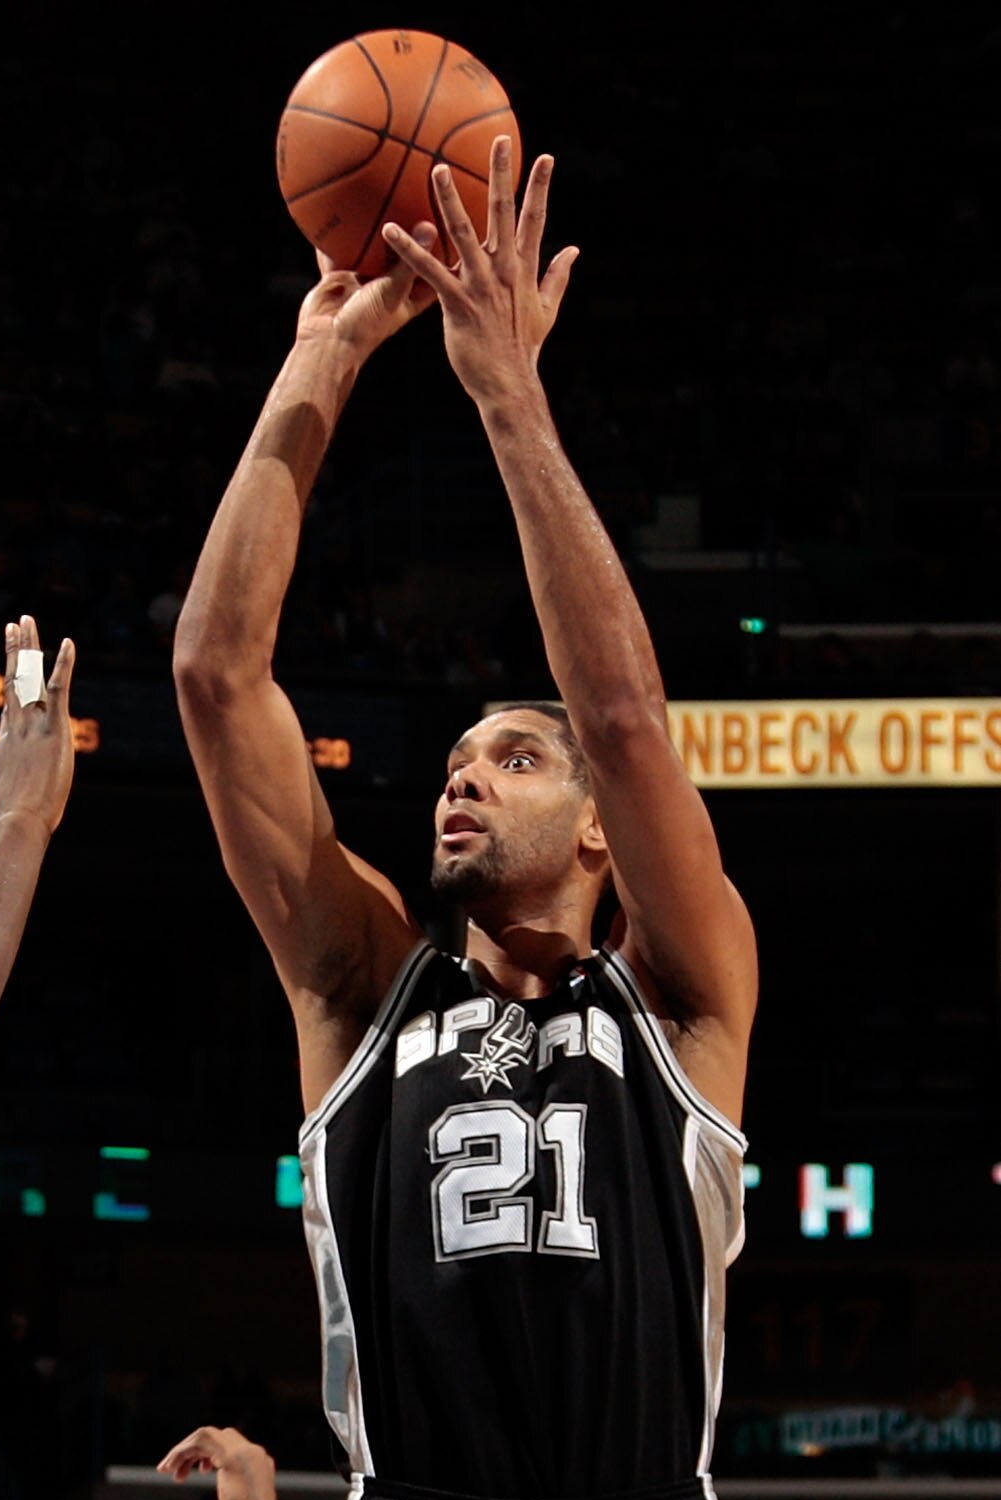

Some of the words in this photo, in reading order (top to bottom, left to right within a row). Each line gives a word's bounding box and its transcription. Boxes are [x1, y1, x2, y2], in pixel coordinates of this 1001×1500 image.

[682, 710, 858, 775] NBECK
[396, 997, 624, 1080] SPURS
[428, 1099, 600, 1263] 21
